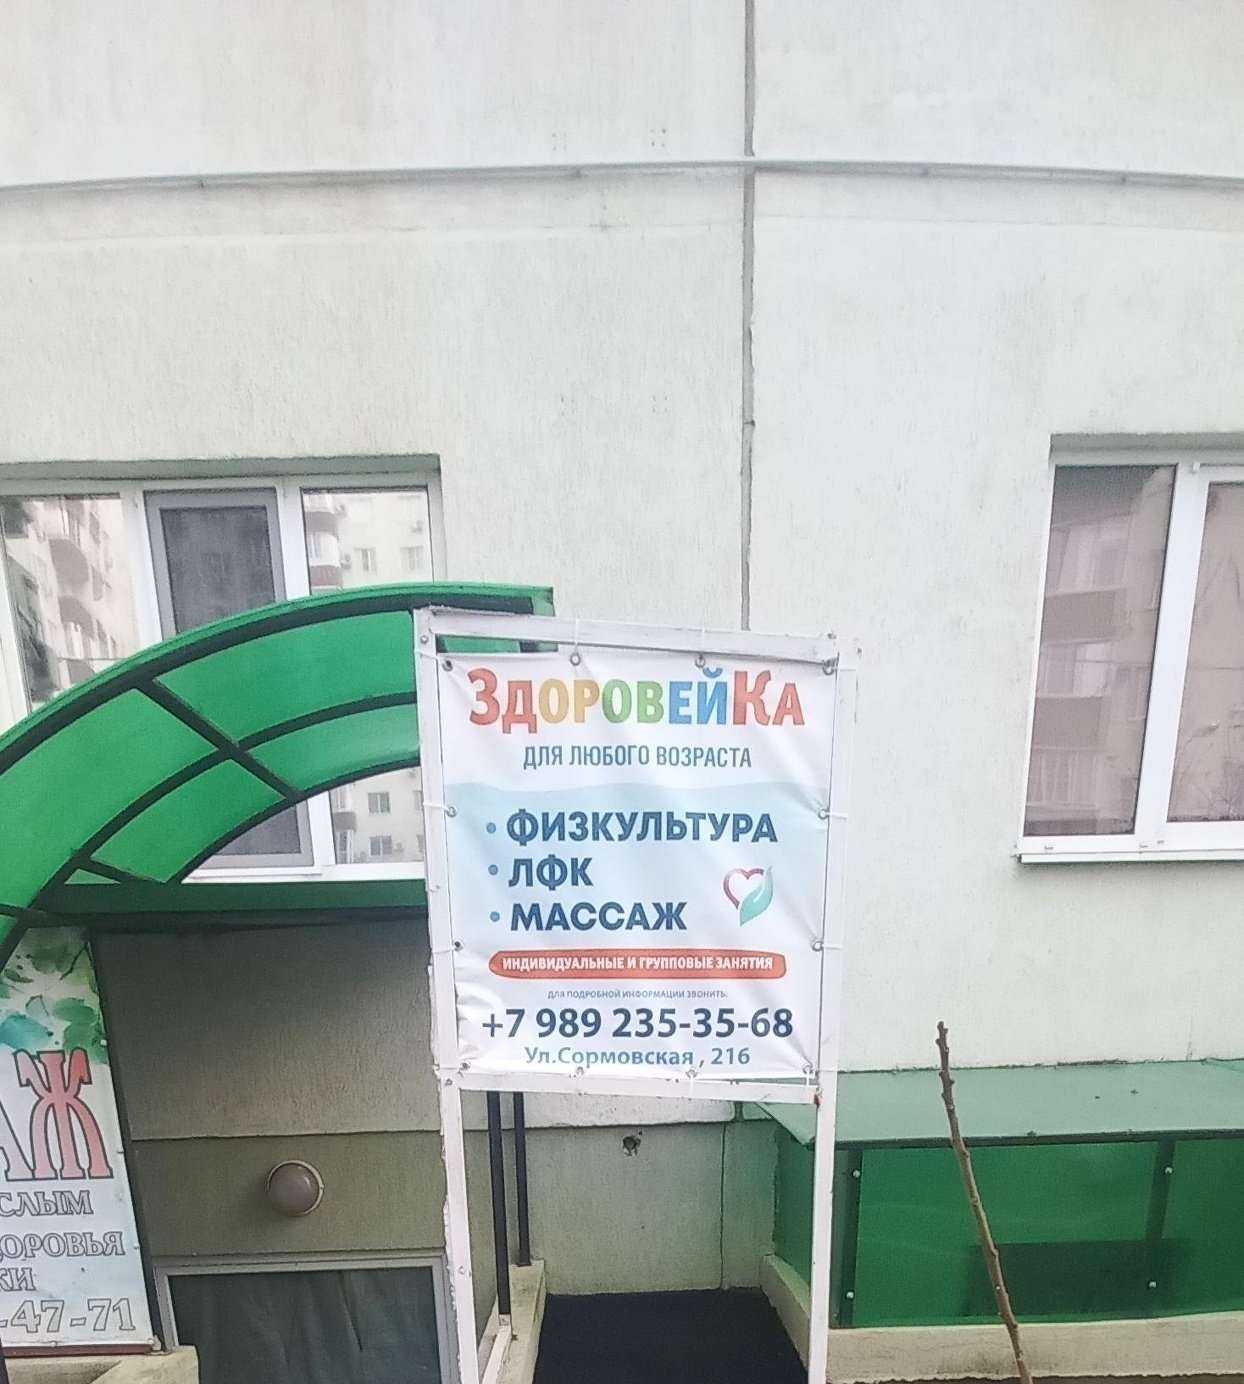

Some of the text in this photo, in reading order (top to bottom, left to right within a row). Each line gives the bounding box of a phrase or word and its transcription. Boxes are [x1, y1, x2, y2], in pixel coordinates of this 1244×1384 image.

[523, 745, 752, 770] ДЛЯ ЛЮБОГО ВОЗРАСТА
[506, 809, 778, 846] ФИЗКУЛЬТУРА
[508, 854, 594, 891] ЛФК
[510, 901, 688, 931] МАССАЖ
[502, 956, 773, 972] ИНДИВИДУАЛЬНЫЕ И ГРУППОВЫЕ ЗАНЯТИЯ
[567, 989, 621, 999] ПОДРОБНОЙ
[622, 990, 685, 999] ИНФОРМАЦИИ
[482, 1008, 793, 1038] +7 989 235-35-68
[711, 1048, 750, 1065] 216
[0, 1231, 126, 1262] ОРОВЬЯ
